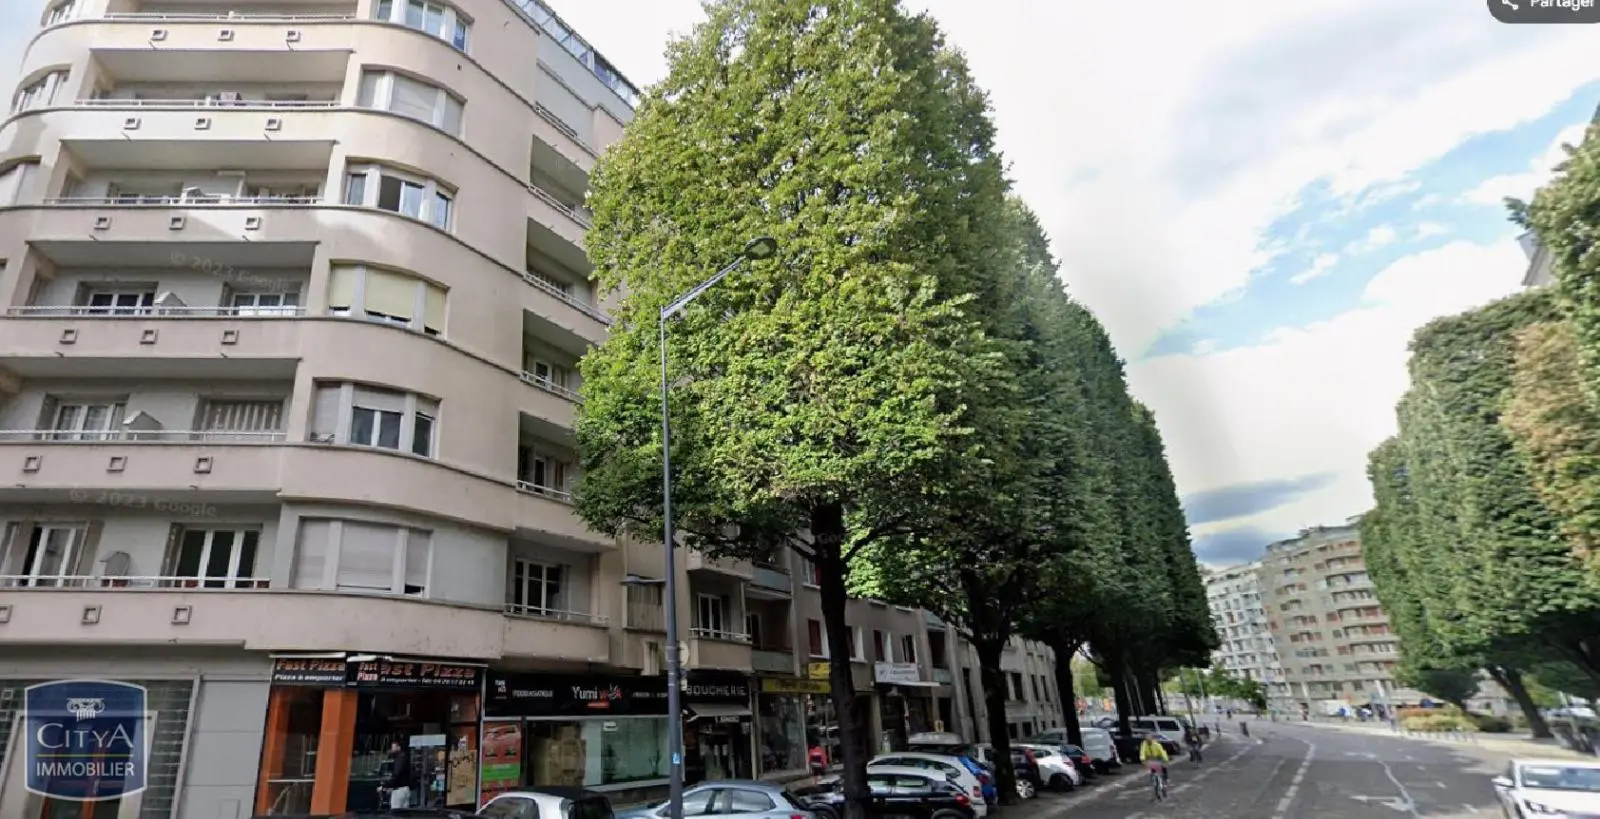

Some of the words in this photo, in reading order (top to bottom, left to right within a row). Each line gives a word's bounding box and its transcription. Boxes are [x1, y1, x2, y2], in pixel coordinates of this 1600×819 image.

[276, 660, 305, 670] Fast
[309, 660, 345, 671] Pizza
[420, 663, 475, 678] Pizza
[571, 685, 598, 700] Yumi
[687, 684, 747, 697] BOUCHERIE
